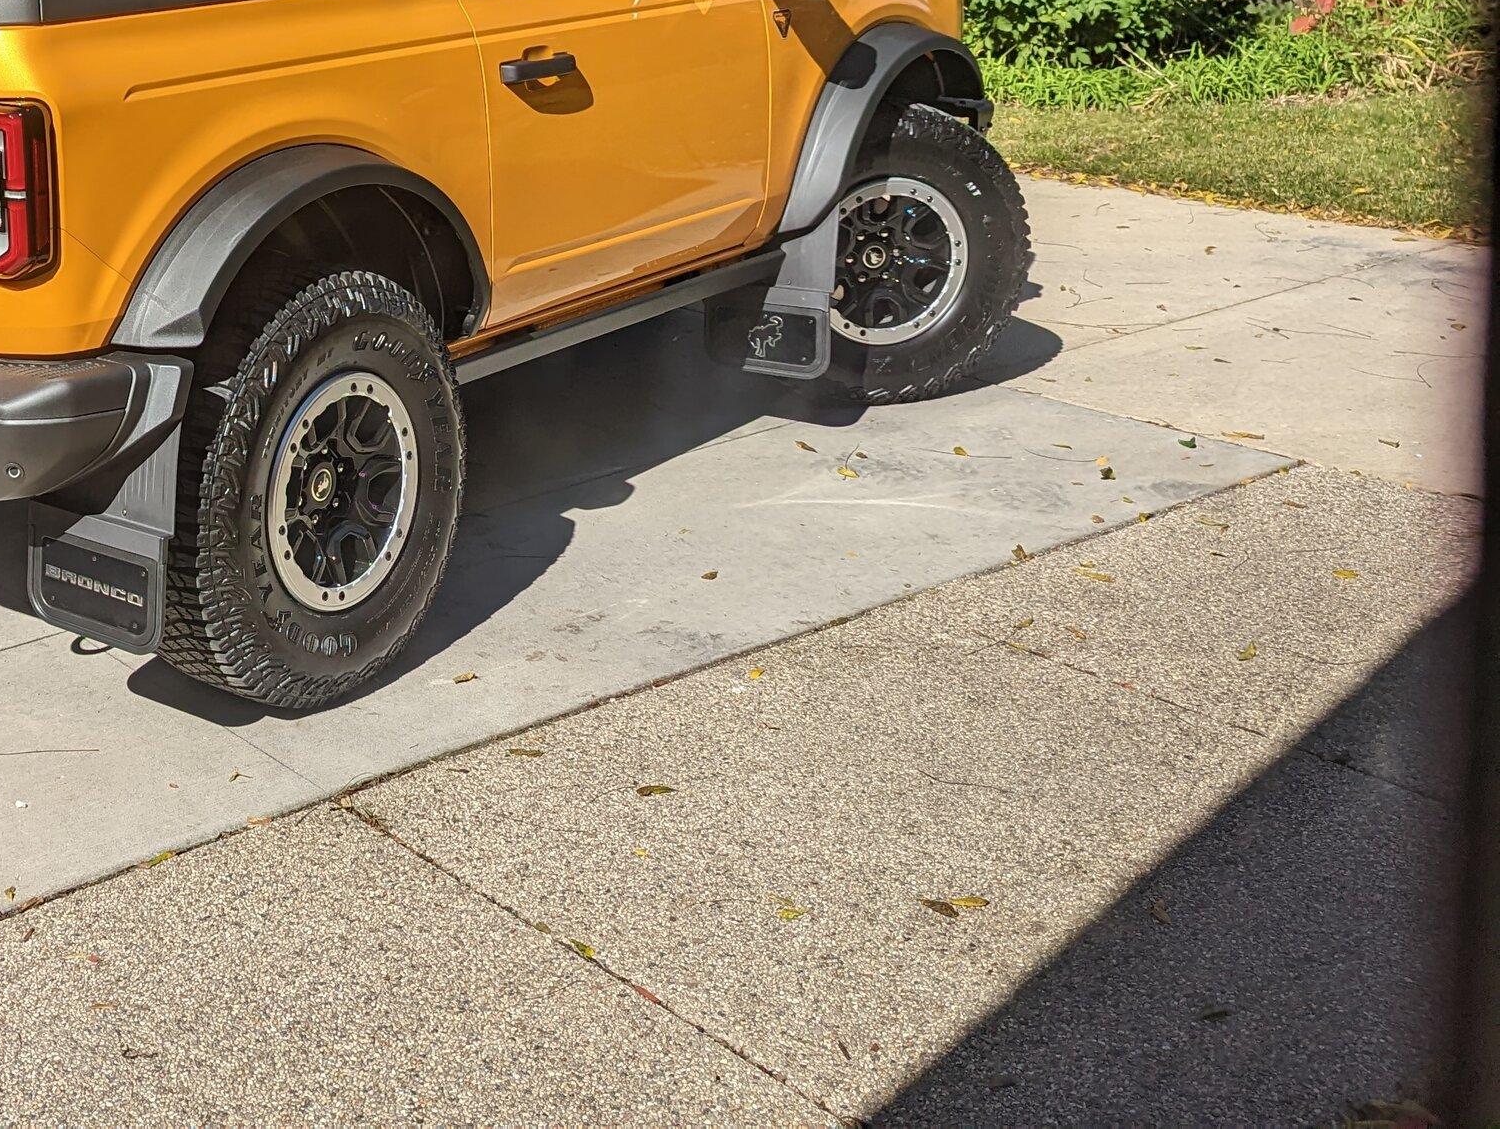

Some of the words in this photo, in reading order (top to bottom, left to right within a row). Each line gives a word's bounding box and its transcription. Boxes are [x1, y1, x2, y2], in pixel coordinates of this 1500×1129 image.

[352, 329, 454, 493] GOODYEAR
[44, 563, 144, 608] BRONCO
[250, 493, 358, 658] GOODYEAR
